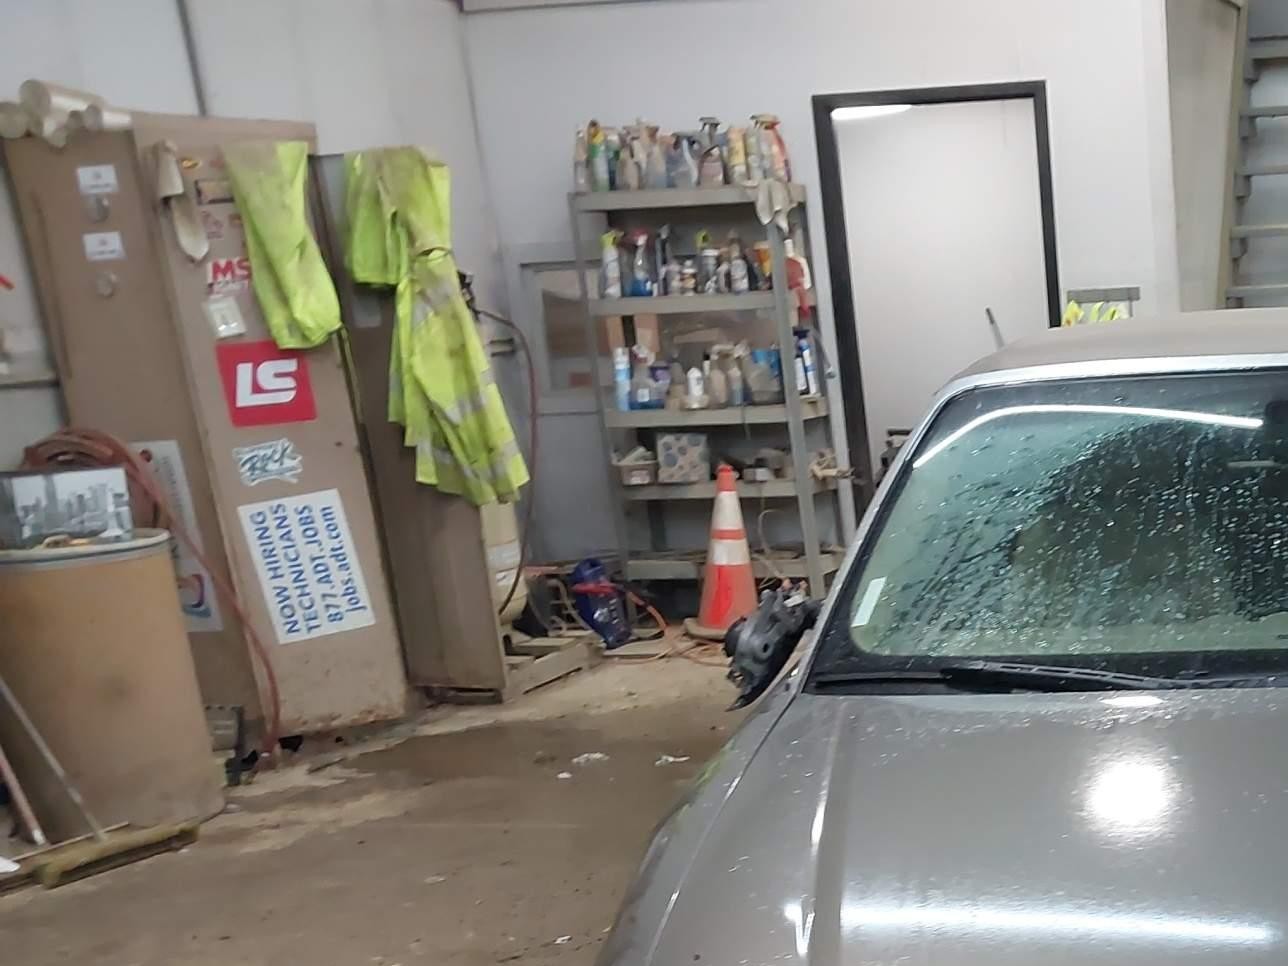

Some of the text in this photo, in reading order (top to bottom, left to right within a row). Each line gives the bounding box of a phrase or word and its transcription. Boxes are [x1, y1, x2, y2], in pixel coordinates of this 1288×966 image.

[249, 511, 301, 635] NOW HIRING
[270, 503, 321, 633] TECHNICIANS
[294, 505, 344, 623] 877.ADT.JOBS
